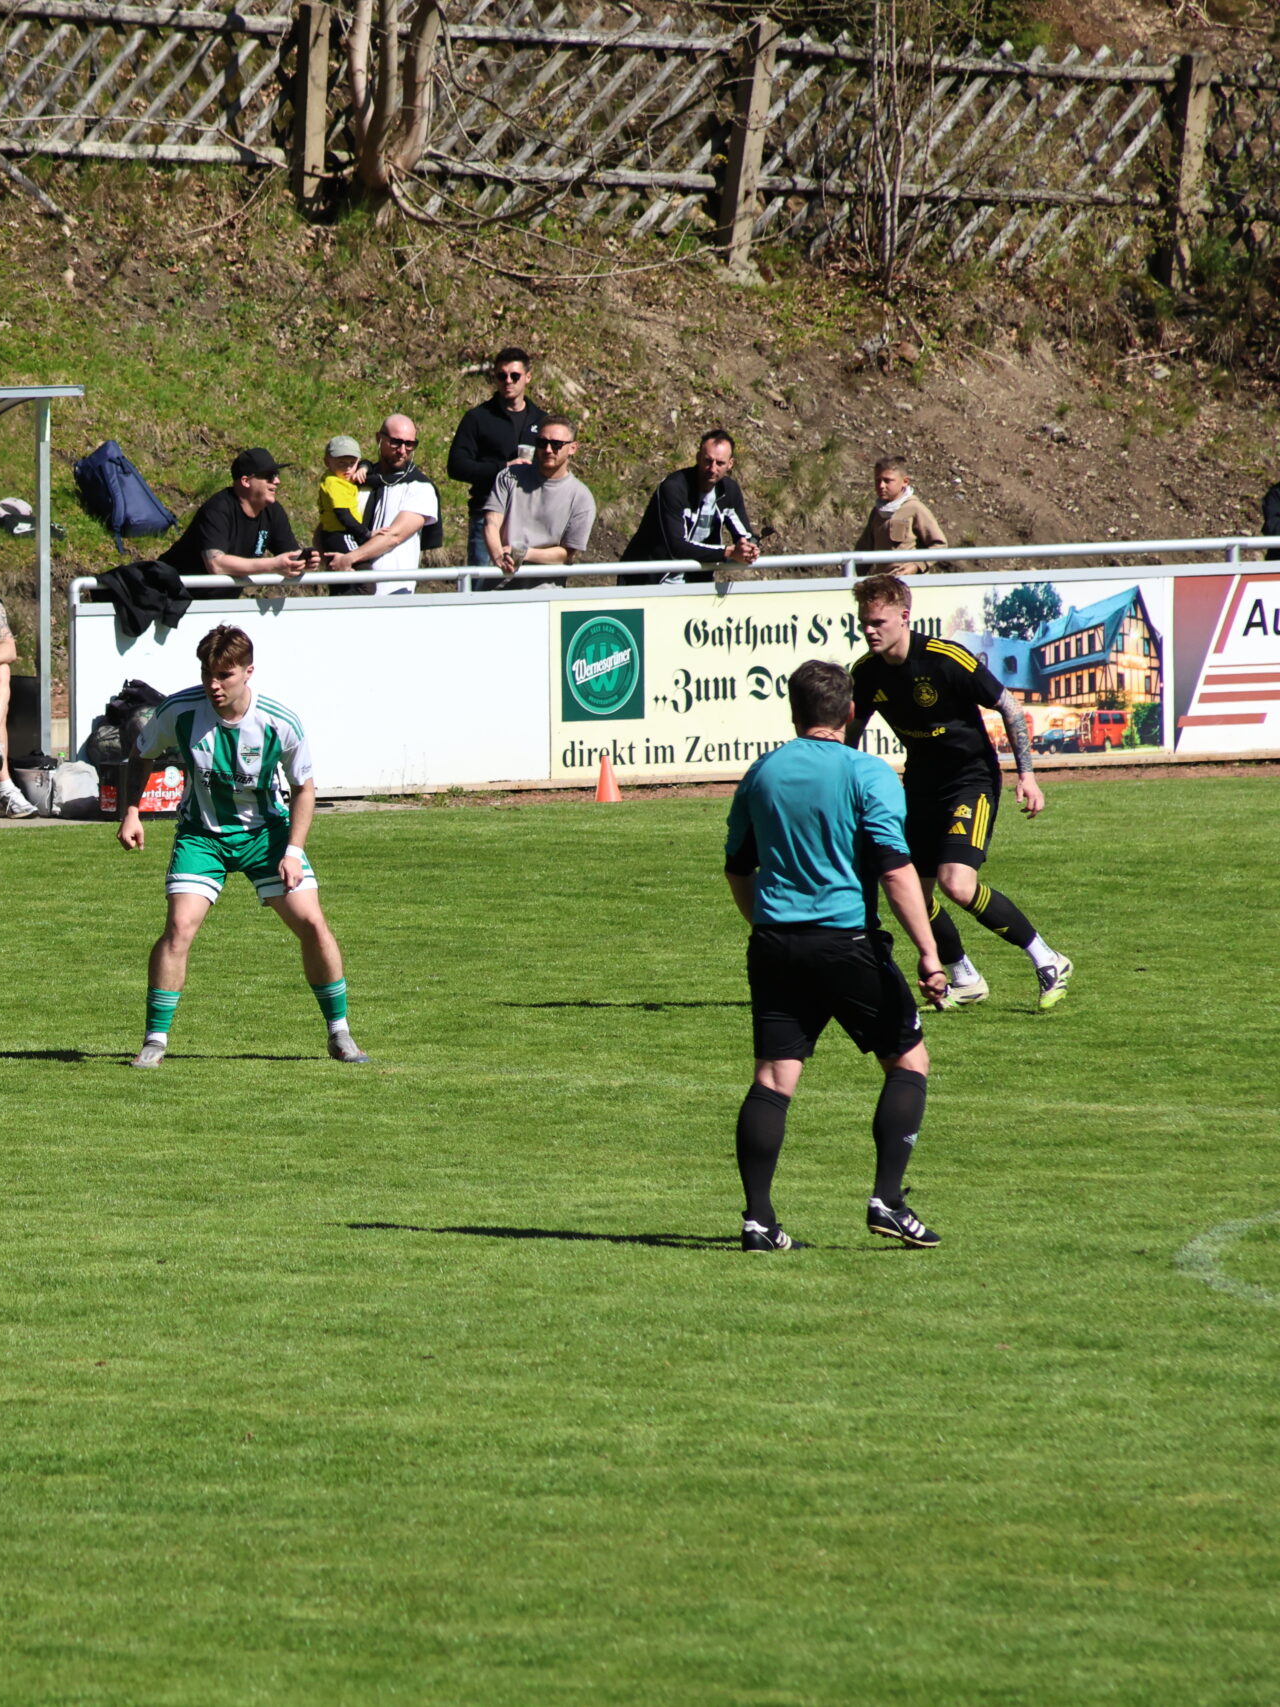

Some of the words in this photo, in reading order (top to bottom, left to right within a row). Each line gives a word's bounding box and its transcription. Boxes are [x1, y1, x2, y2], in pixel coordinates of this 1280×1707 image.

[808, 614, 832, 646] &
[572, 648, 631, 685] Wernesgrüner
[645, 738, 675, 764] im
